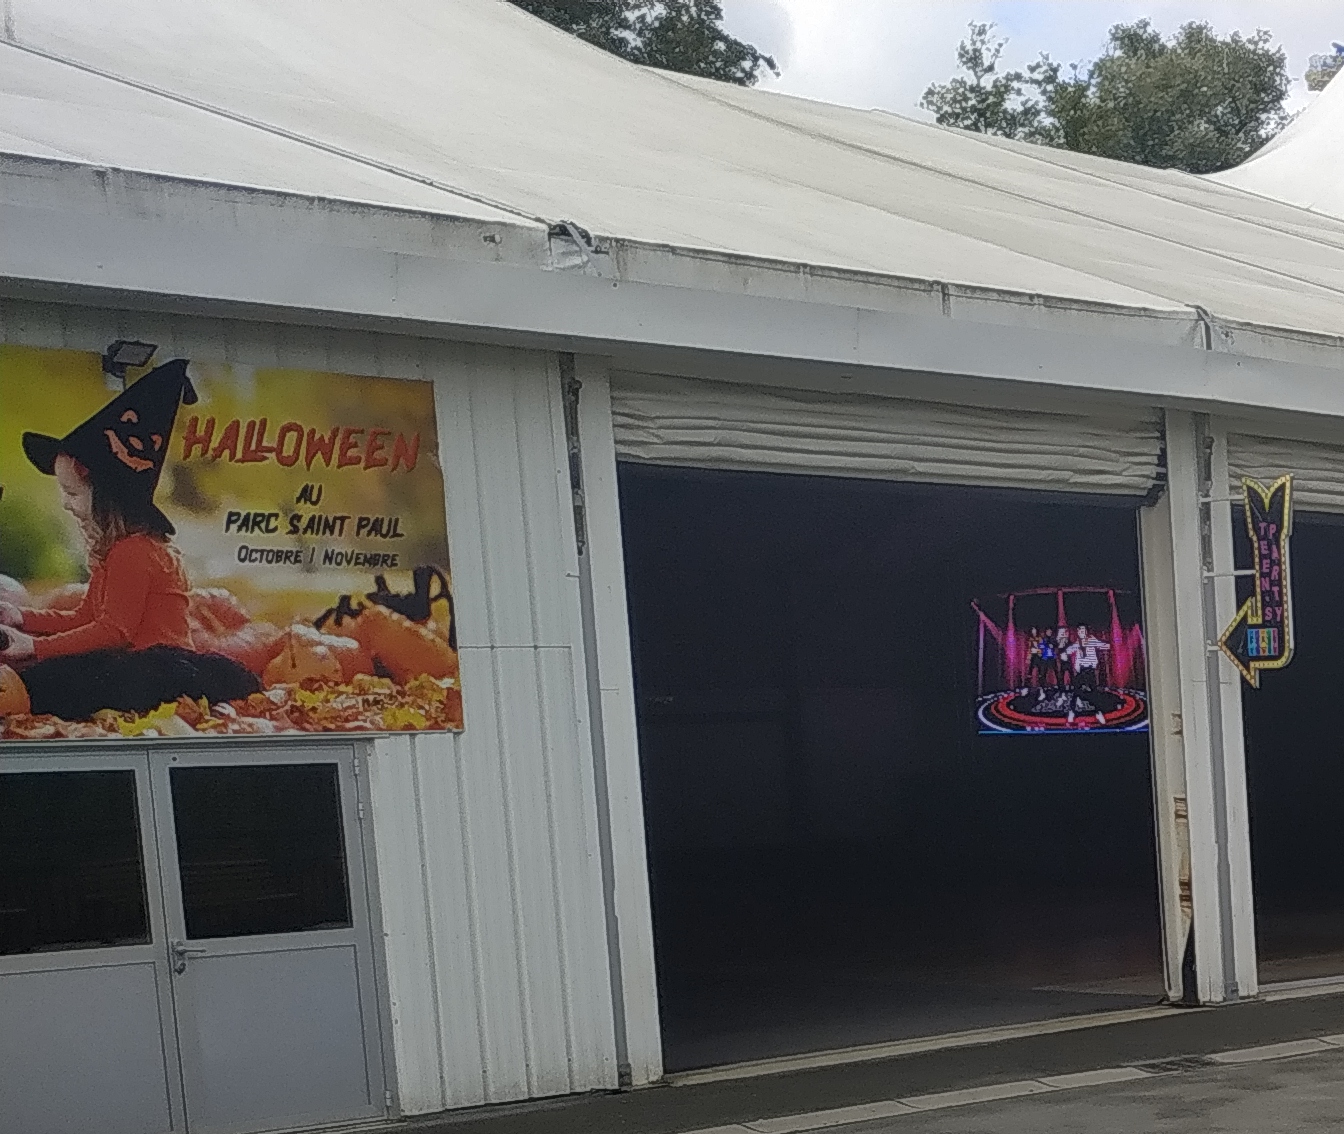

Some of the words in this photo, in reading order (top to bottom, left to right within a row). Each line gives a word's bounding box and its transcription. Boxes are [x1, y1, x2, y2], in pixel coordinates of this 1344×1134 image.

[182, 415, 421, 473] HALLOWEEN
[295, 483, 323, 507] AU
[225, 511, 280, 535] PARC
[285, 514, 352, 538] SAINT
[355, 516, 405, 540] PAUL
[1268, 523, 1283, 622] PARTY
